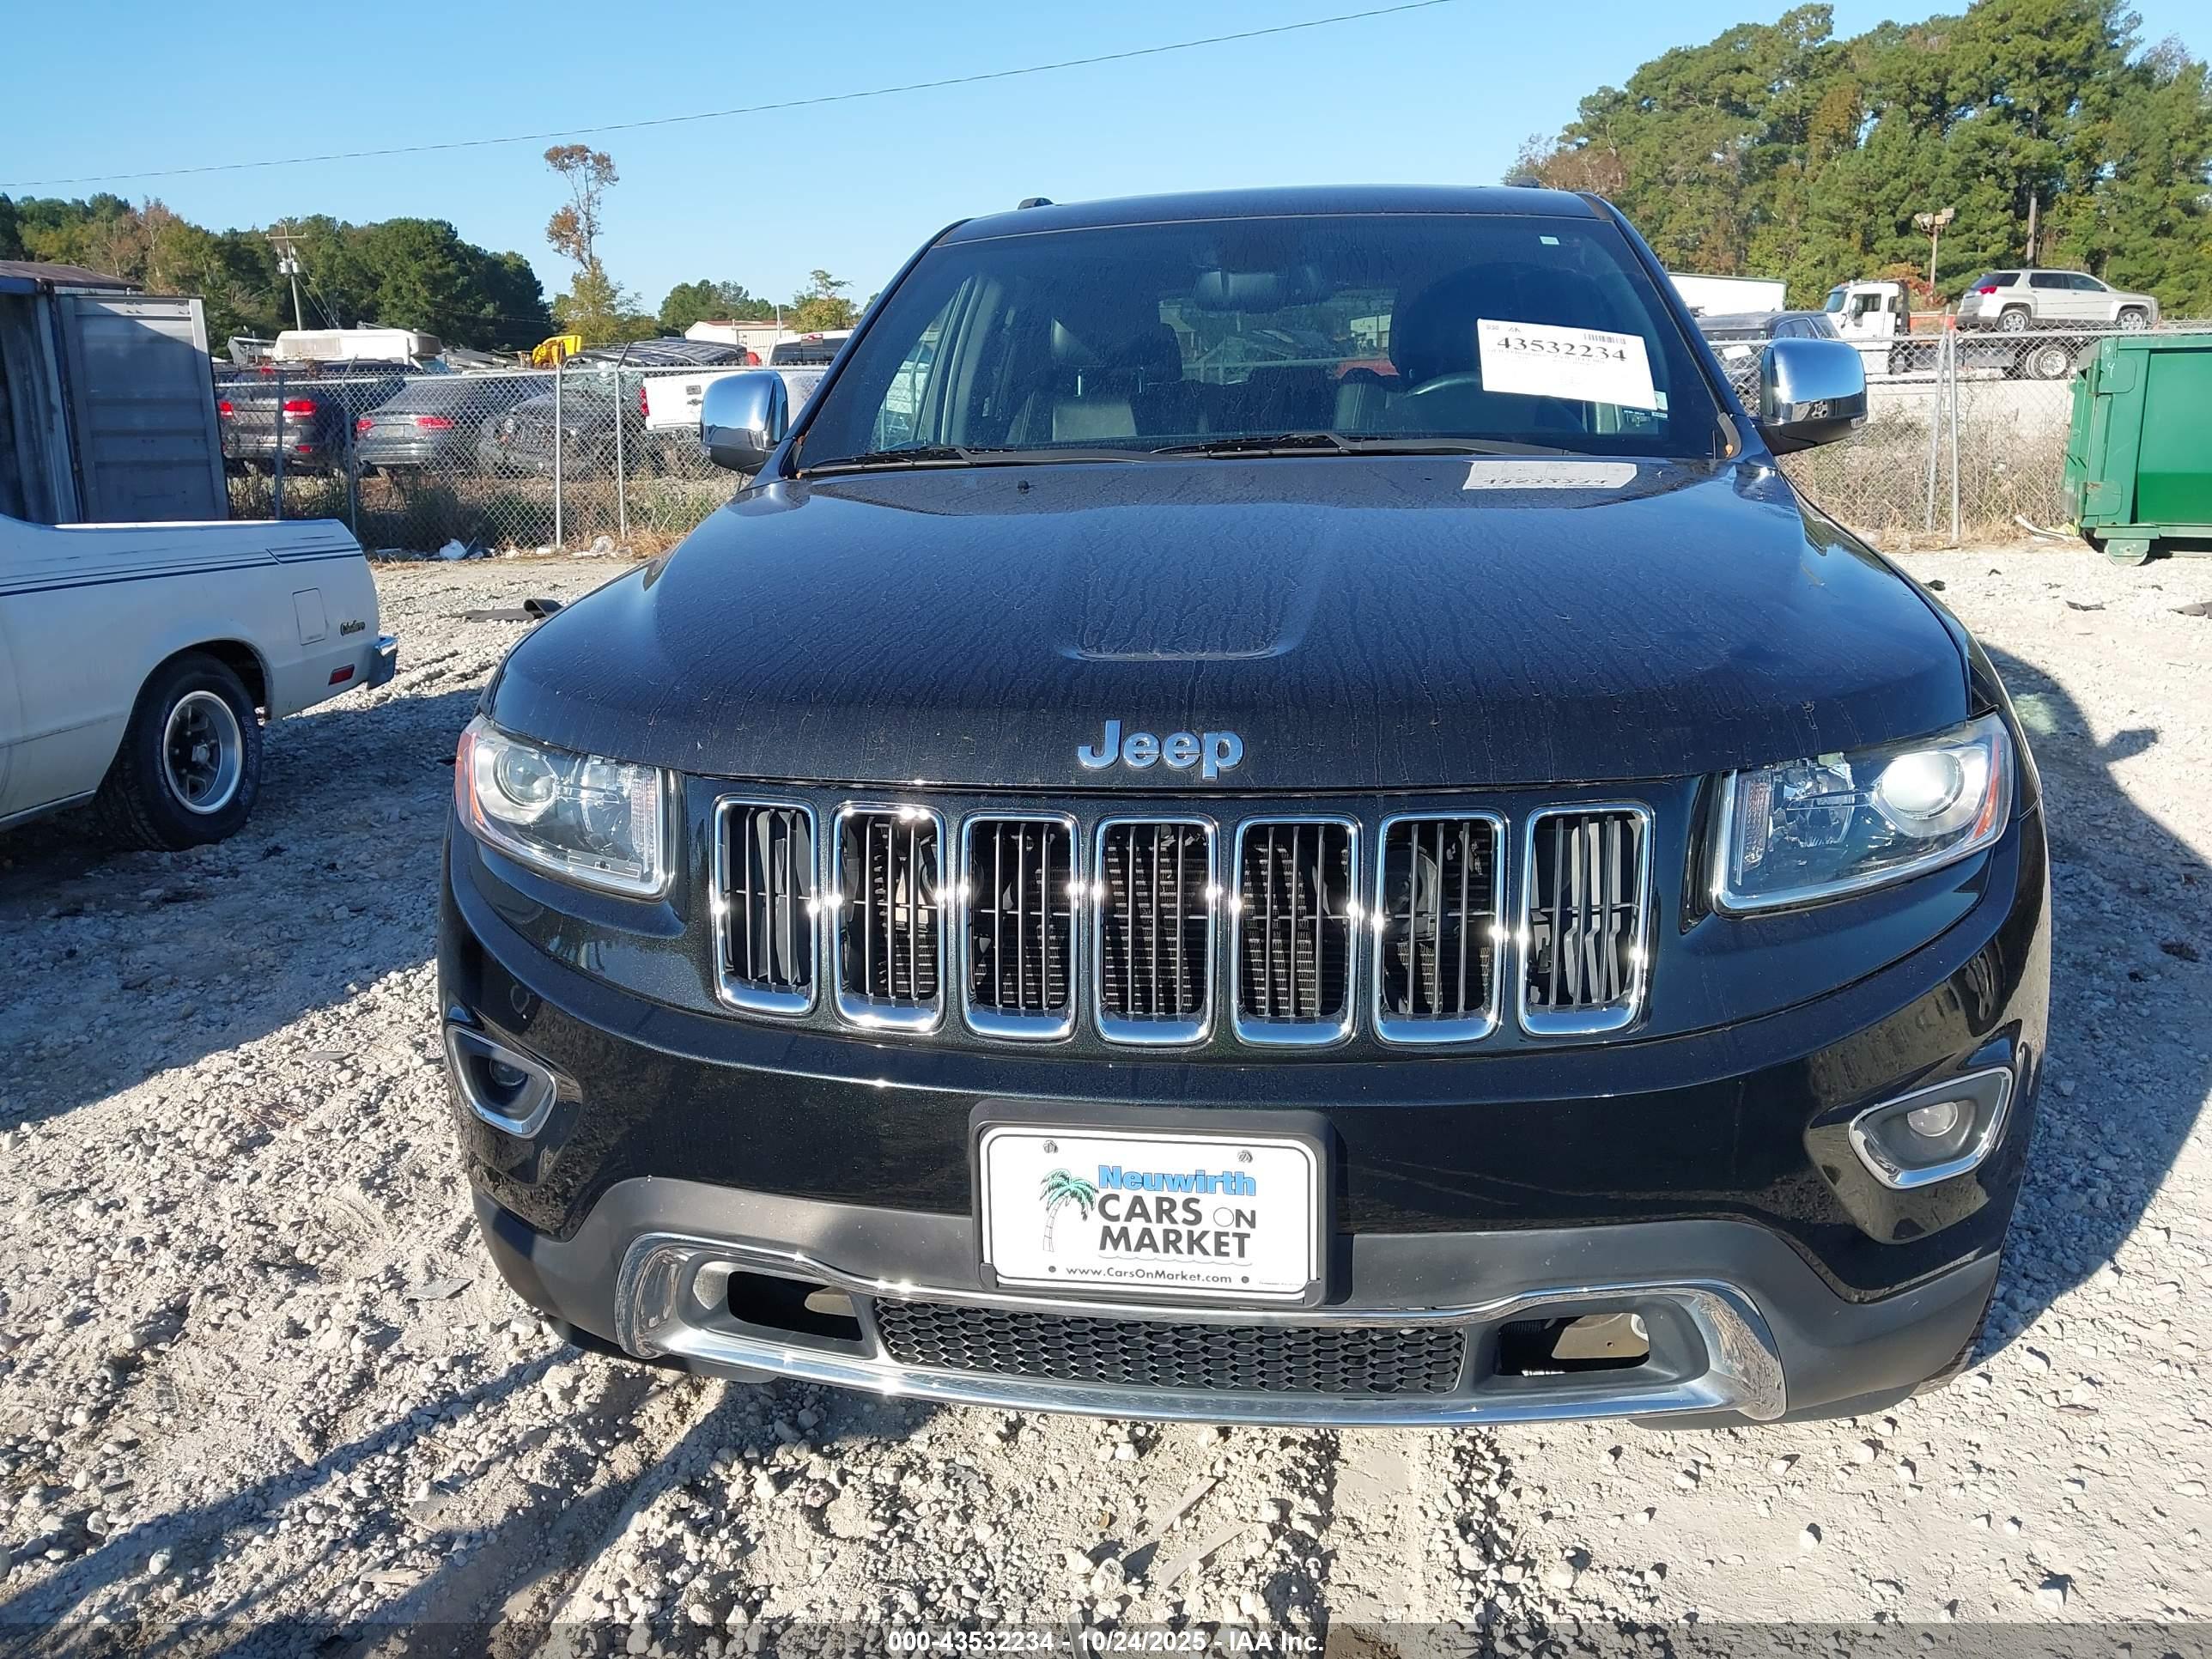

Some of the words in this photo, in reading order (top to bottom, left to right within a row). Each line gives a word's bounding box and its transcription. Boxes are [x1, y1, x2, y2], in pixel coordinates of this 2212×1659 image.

[1497, 337, 1627, 362] 43532234
[1078, 720, 1244, 781] Jeep
[1097, 1164, 1256, 1197] Neuwirth
[1097, 1194, 1203, 1226] CARS
[1212, 1206, 1256, 1229] ON
[1098, 1224, 1251, 1259] MARKET
[1066, 1267, 1232, 1284] www.CarsOnMarket.com
